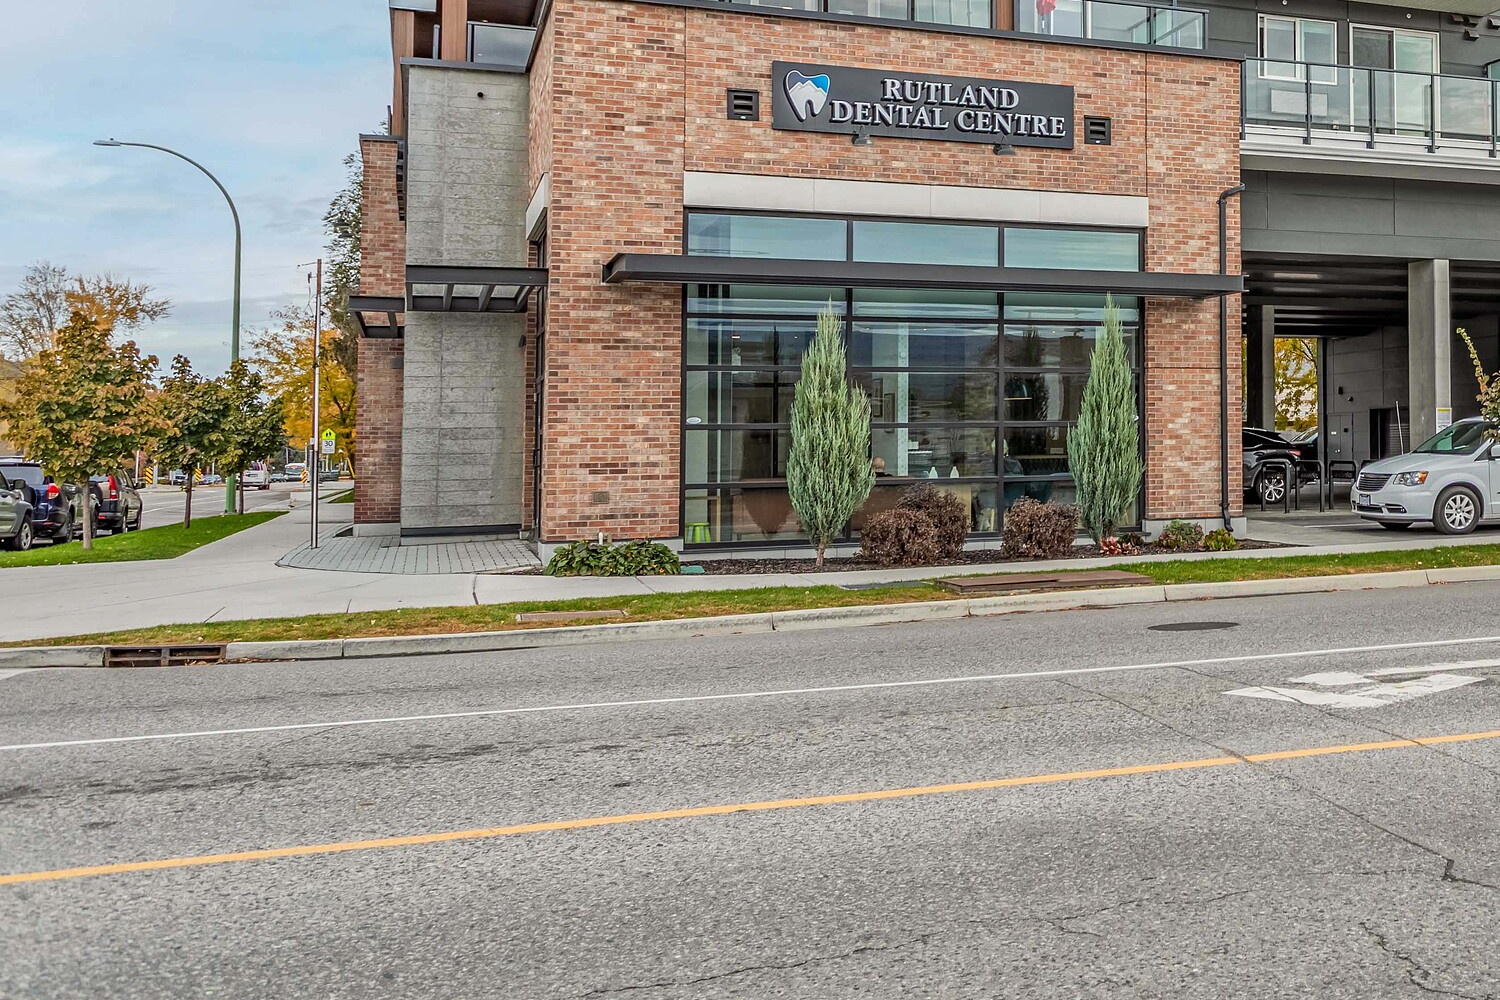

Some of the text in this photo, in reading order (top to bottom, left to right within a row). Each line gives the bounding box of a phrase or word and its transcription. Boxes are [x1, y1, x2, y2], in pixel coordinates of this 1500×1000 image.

[882, 78, 1020, 110] RUTLAND
[830, 100, 1067, 138] DENTAL CENTRE
